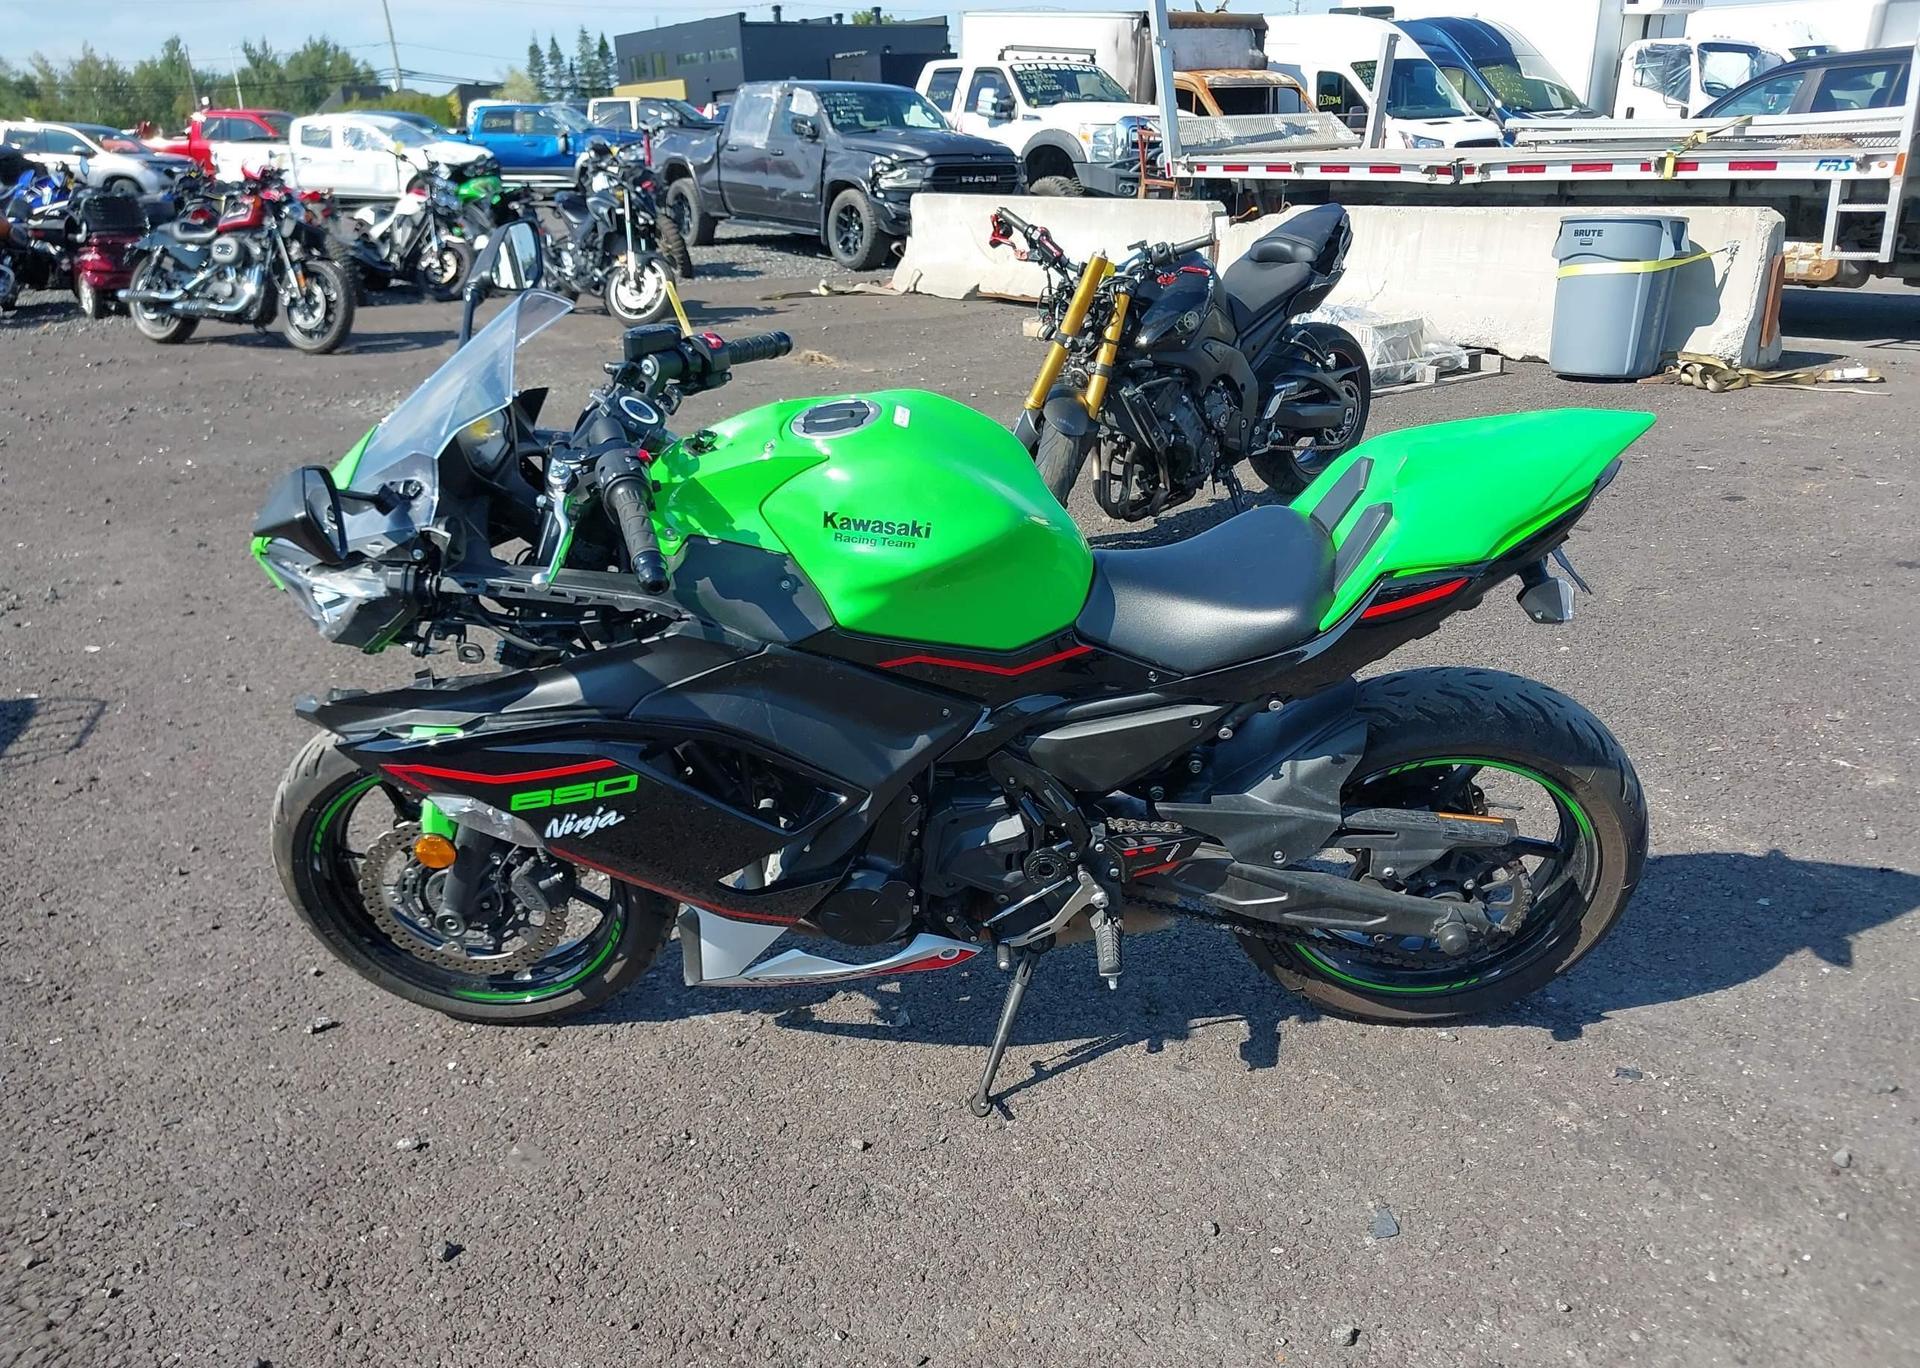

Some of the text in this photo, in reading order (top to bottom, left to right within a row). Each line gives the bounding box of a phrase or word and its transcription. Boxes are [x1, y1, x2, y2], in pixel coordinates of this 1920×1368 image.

[1815, 159, 1854, 171] FRS
[1573, 229, 1604, 237] BRUTE
[823, 511, 932, 539] Kawasaki
[834, 533, 916, 549] Racing Team
[510, 774, 639, 811] 650
[544, 806, 625, 839] Ninja
